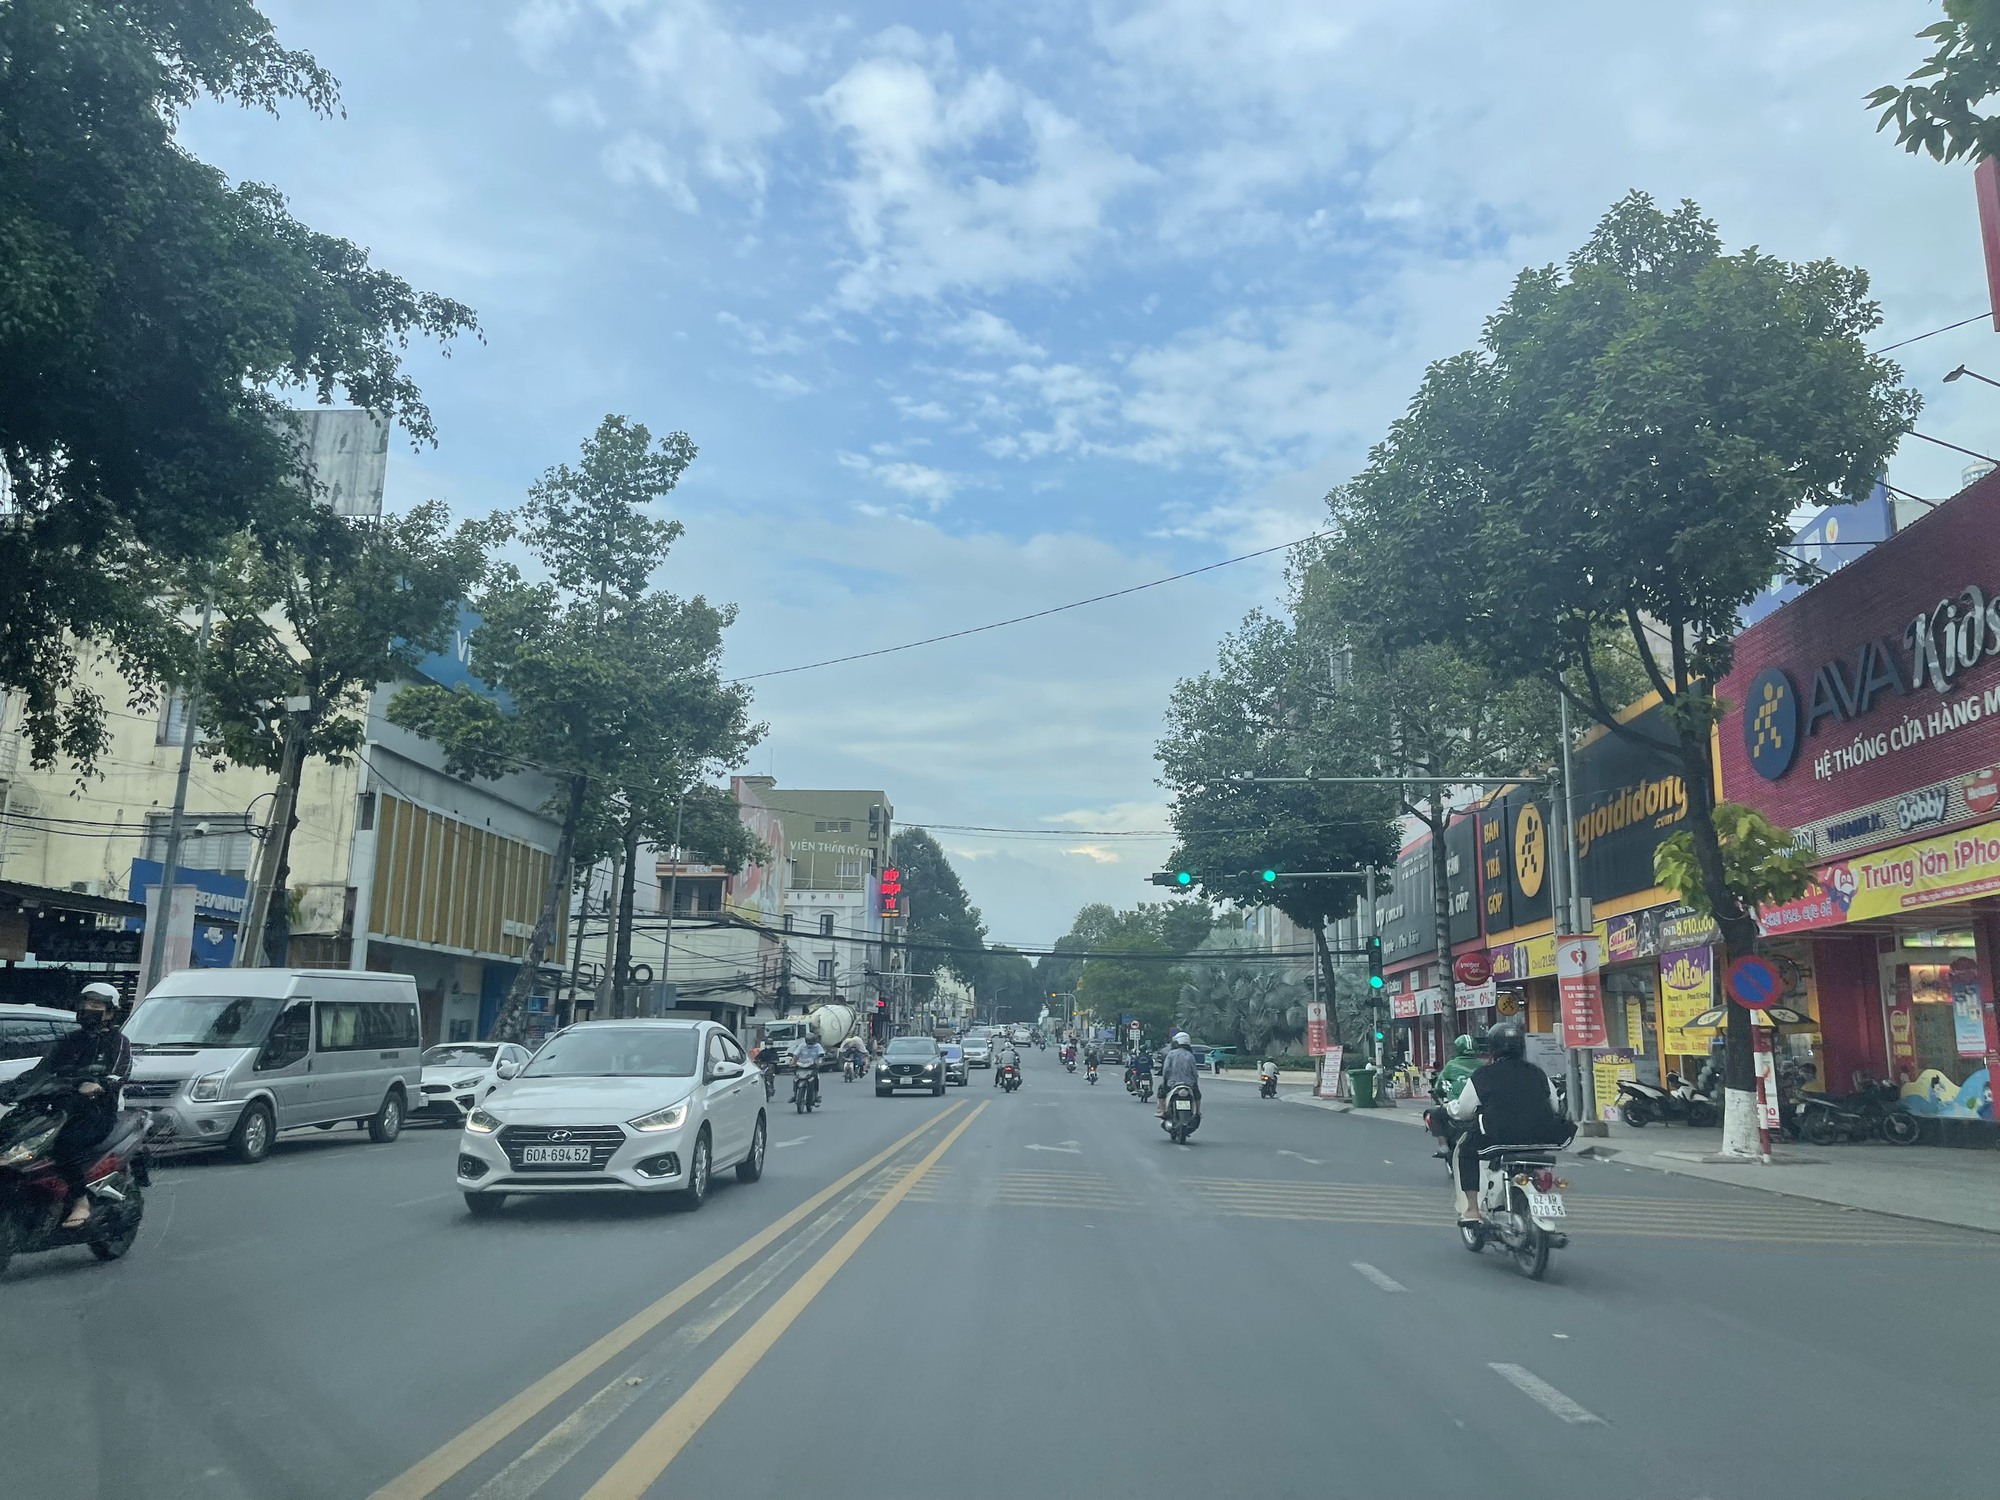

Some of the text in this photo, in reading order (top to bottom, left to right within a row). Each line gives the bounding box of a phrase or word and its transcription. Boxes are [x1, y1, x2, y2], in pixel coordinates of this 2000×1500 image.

[1804, 634, 1904, 736] AVA
[1814, 750, 1832, 781] HỆ
[1833, 732, 1888, 772] THỐNG
[1890, 715, 1926, 751] CỬA
[1927, 696, 1982, 738] HÀNG
[1897, 790, 1948, 830] Bobby
[1861, 858, 1914, 887] Trúng
[1920, 847, 1949, 877] lớn
[525, 1148, 589, 1163] 60A-694.52
